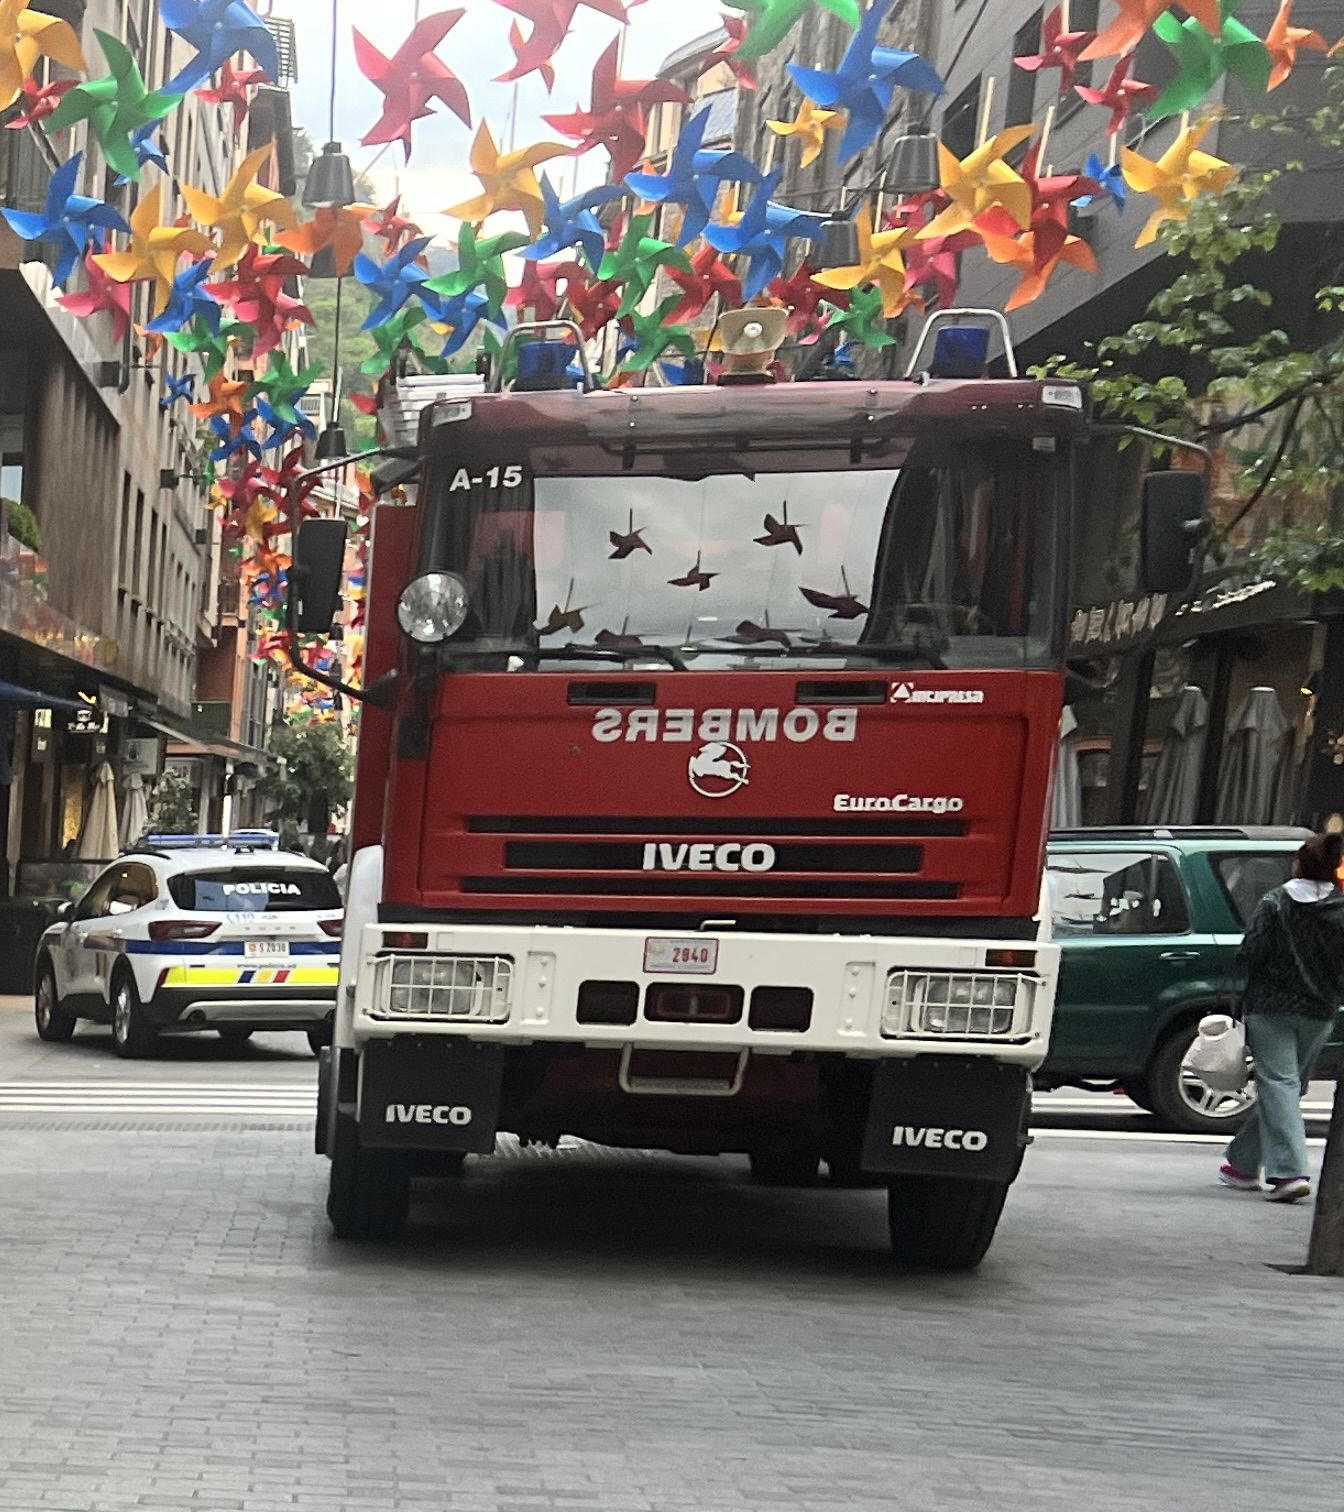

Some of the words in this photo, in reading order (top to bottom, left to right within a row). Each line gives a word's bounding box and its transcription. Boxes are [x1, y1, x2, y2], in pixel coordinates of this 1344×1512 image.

[448, 464, 523, 493] A-15
[833, 792, 964, 815] EuroCargo
[641, 841, 778, 873] IVECO
[222, 882, 302, 896] POLICIA
[385, 1103, 472, 1126] IVECO
[891, 1125, 989, 1152] IVECO
